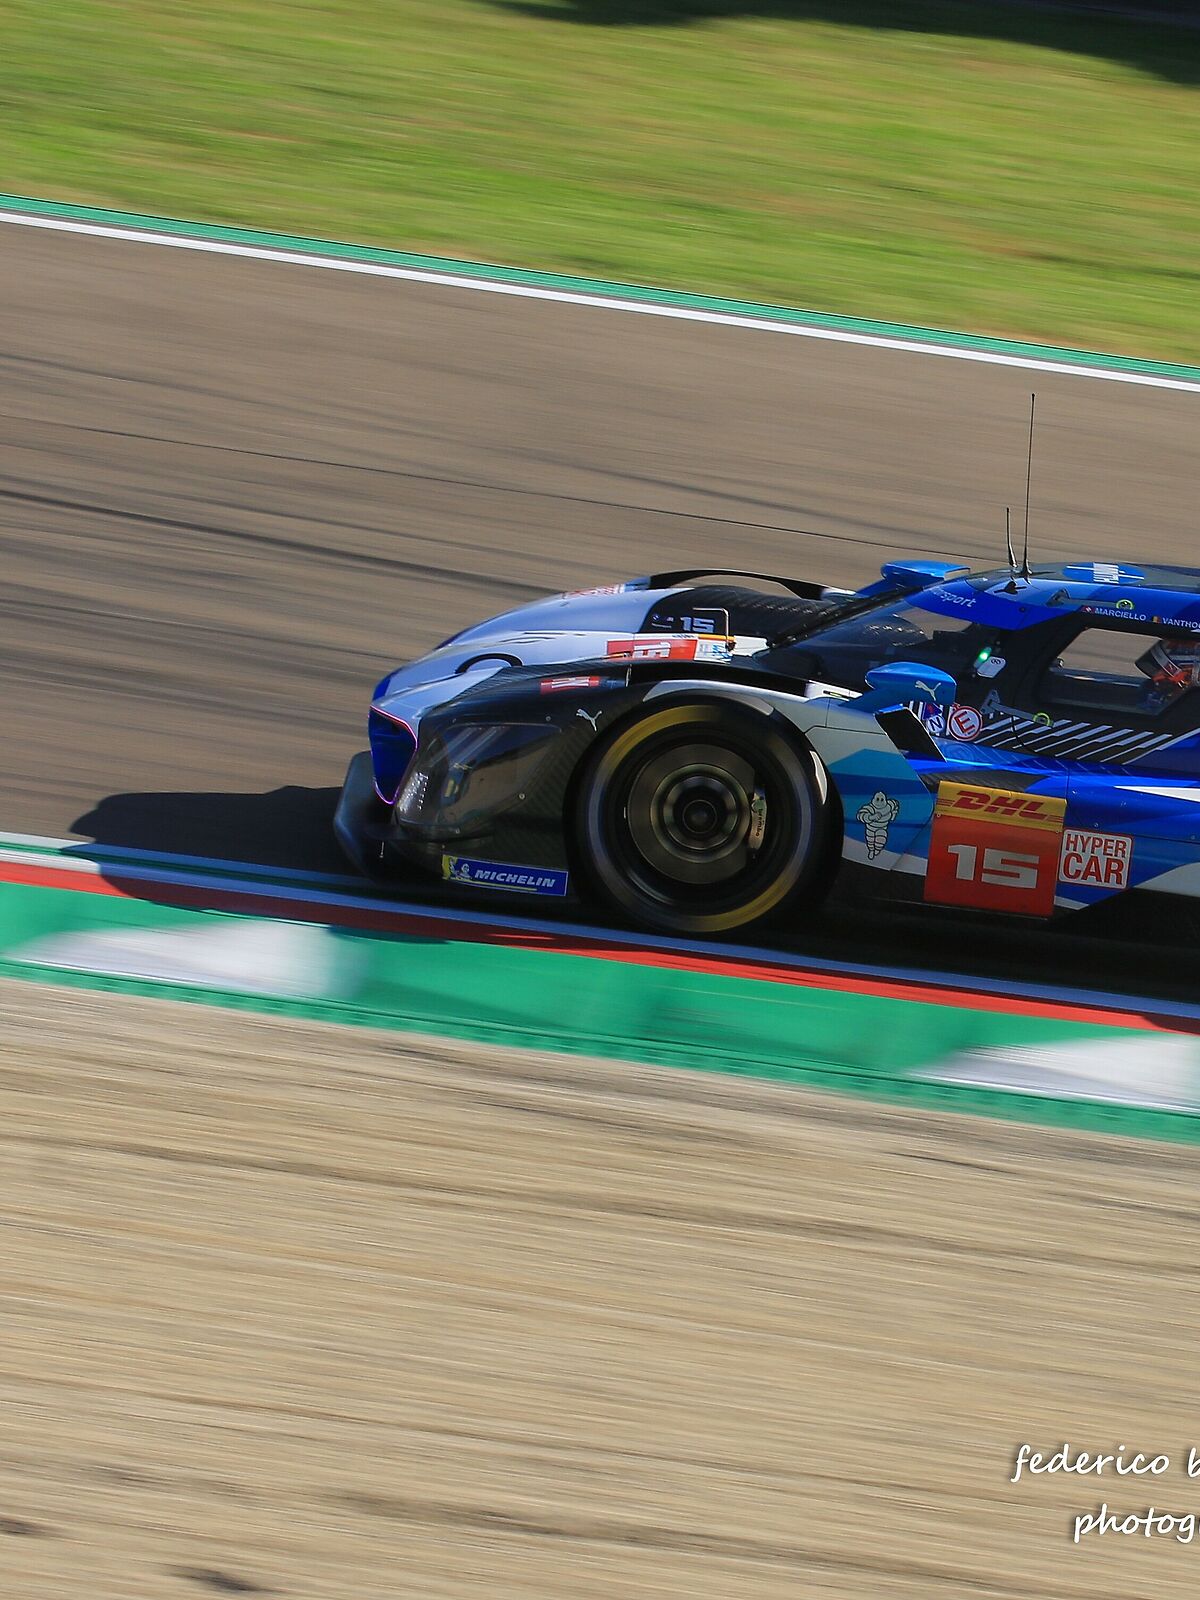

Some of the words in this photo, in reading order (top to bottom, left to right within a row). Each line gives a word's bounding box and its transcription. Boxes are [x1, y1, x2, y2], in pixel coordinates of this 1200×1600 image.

[679, 616, 715, 633] 15
[1094, 607, 1147, 621] MARCIELLO
[952, 790, 1048, 821] DHL
[1065, 833, 1127, 858] HYPER
[474, 869, 556, 888] MICHELIN
[947, 844, 1040, 889] 15
[1062, 853, 1125, 885] CAR
